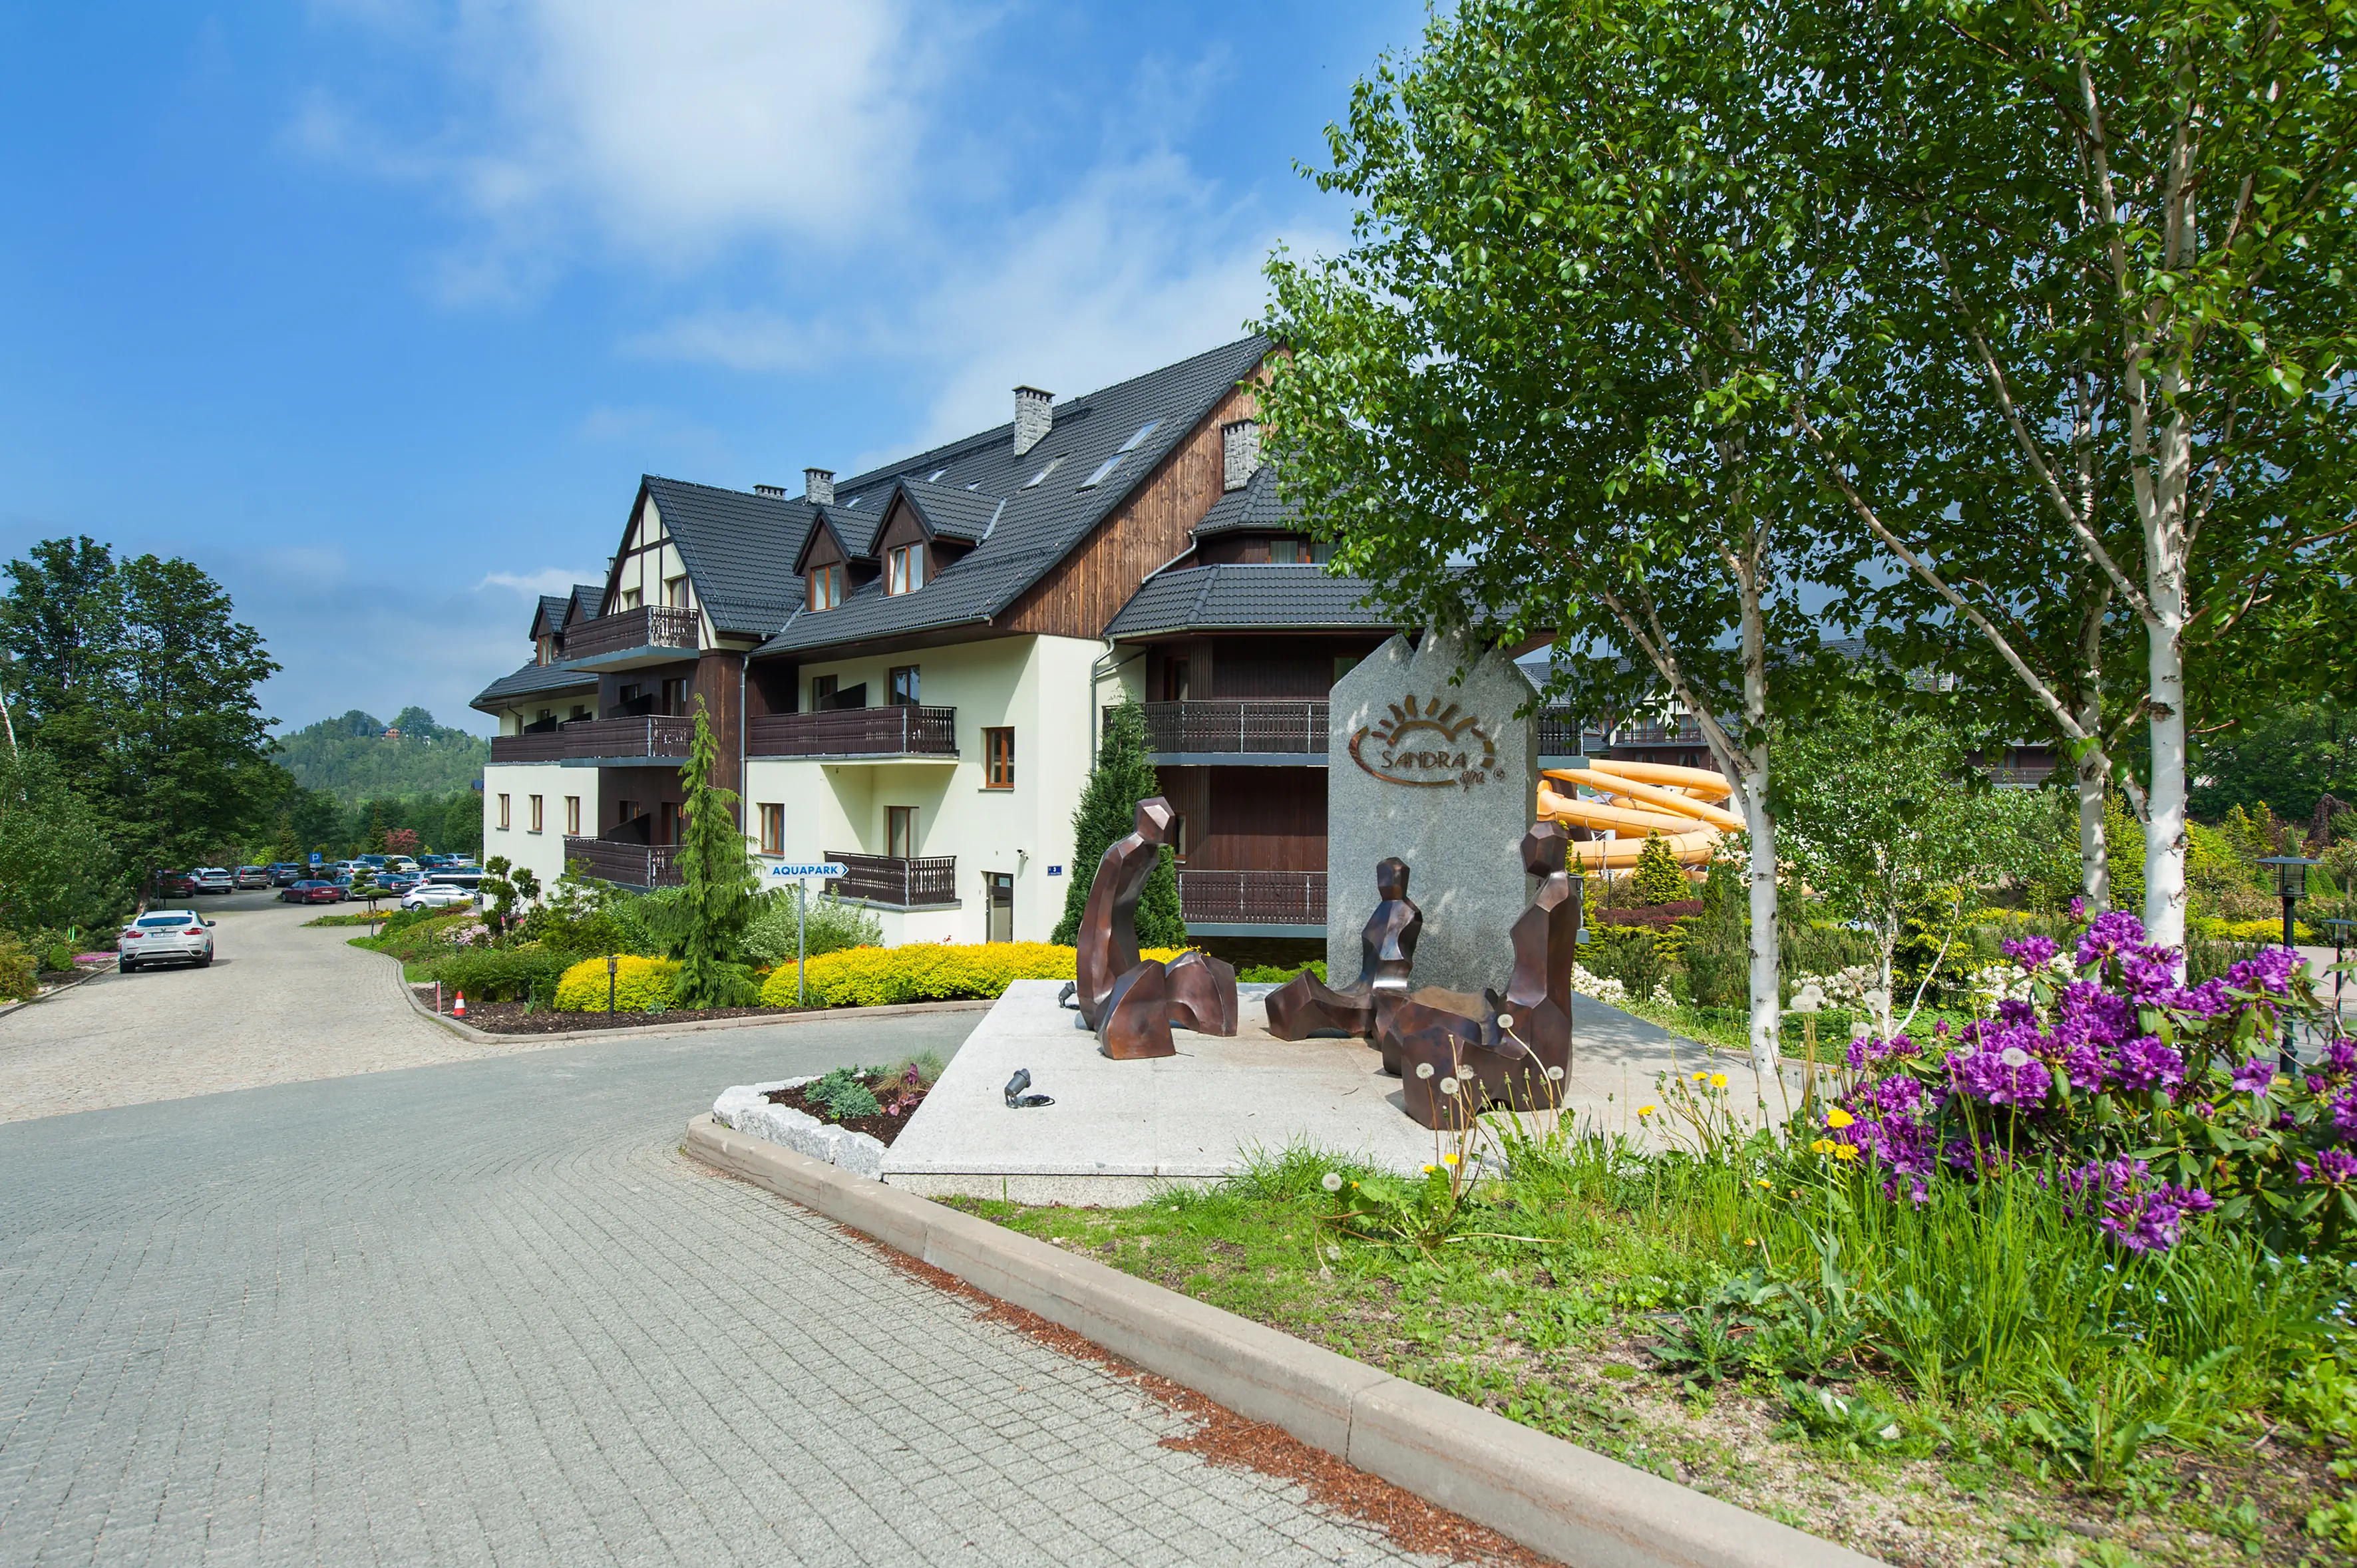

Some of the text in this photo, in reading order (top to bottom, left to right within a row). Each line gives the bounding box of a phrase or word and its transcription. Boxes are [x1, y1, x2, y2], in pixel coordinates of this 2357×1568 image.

[1381, 750, 1467, 769] SANDRA
[1459, 770, 1485, 792] spa
[772, 865, 838, 875] AQUAPARK
